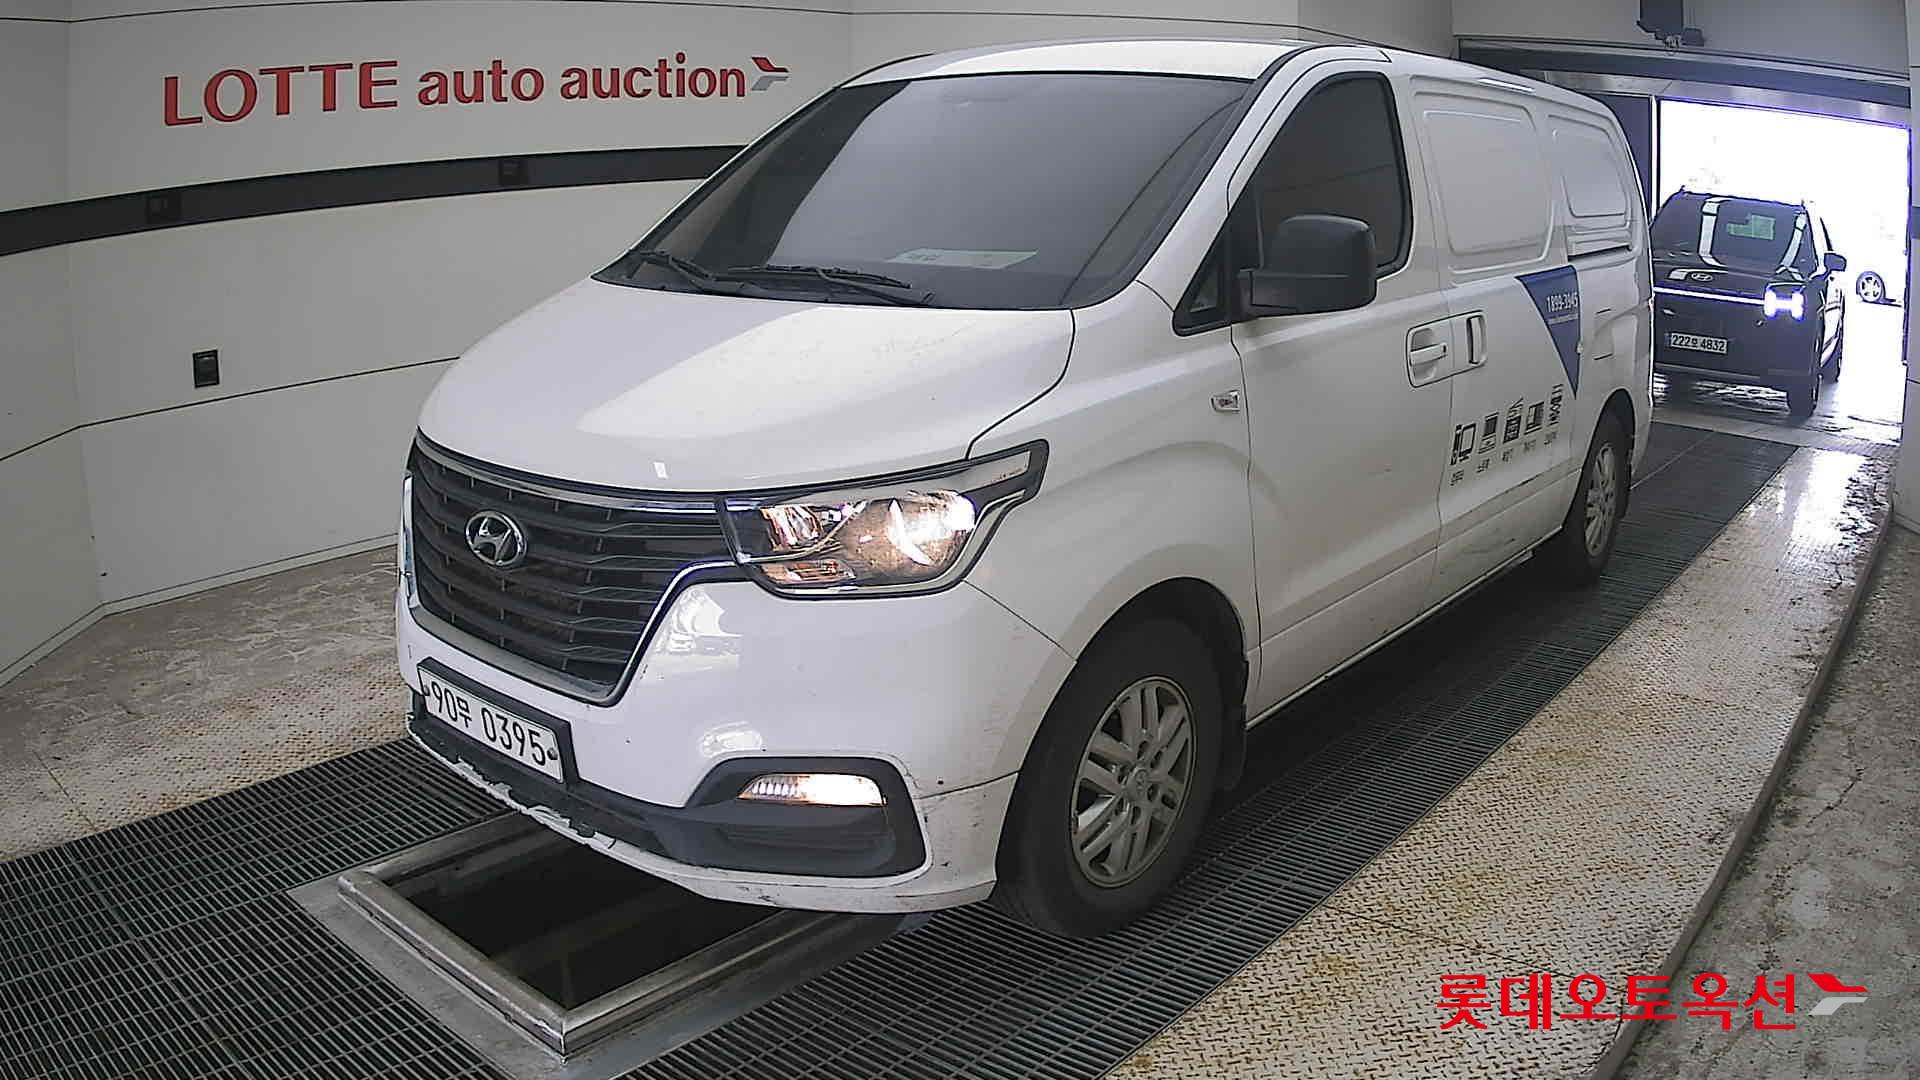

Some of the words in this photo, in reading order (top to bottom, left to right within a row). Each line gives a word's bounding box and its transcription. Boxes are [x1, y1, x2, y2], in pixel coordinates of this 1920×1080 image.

[164, 60, 398, 126] LOTTE
[417, 59, 545, 105] auto
[560, 52, 747, 100] auction
[431, 681, 473, 728] 90무
[481, 707, 546, 766] 0395
